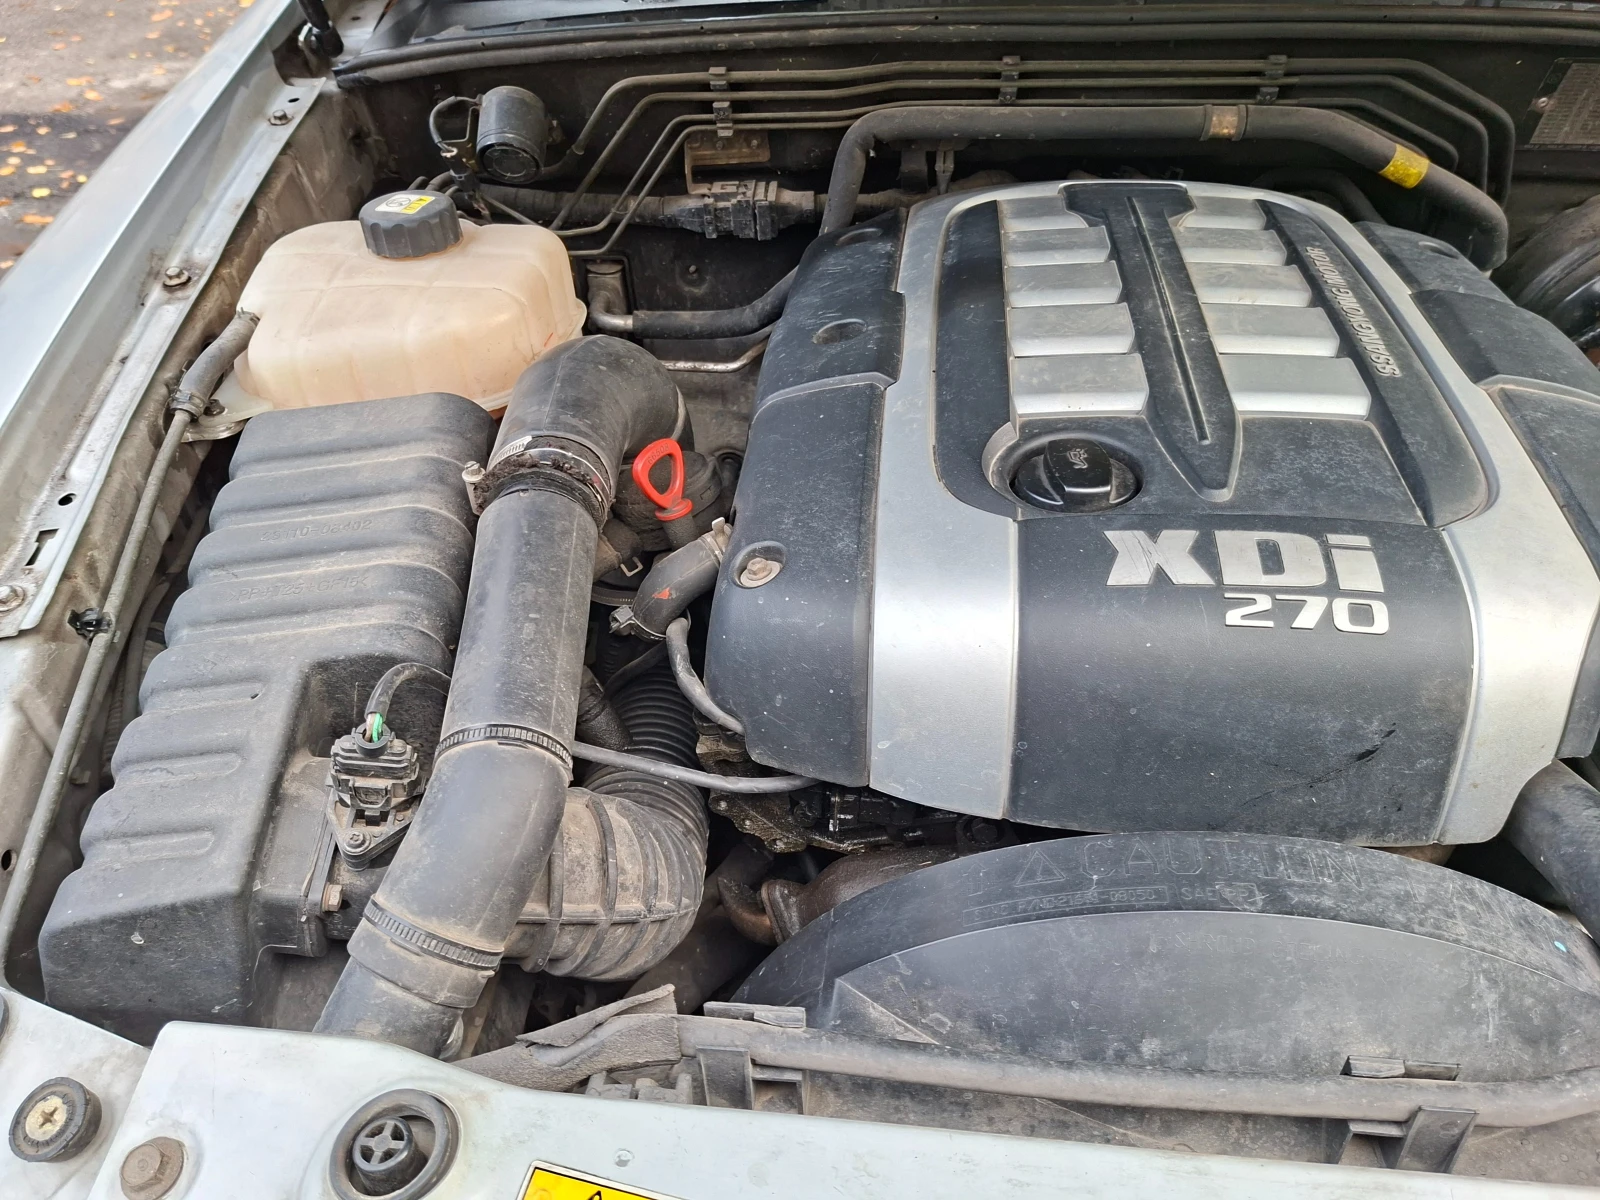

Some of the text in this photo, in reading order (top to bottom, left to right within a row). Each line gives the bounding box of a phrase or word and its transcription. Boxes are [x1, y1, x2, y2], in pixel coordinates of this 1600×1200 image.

[1305, 246, 1401, 377] SSANGYONG MOTOR
[1103, 529, 1385, 593] XDi
[1223, 593, 1390, 635] 270
